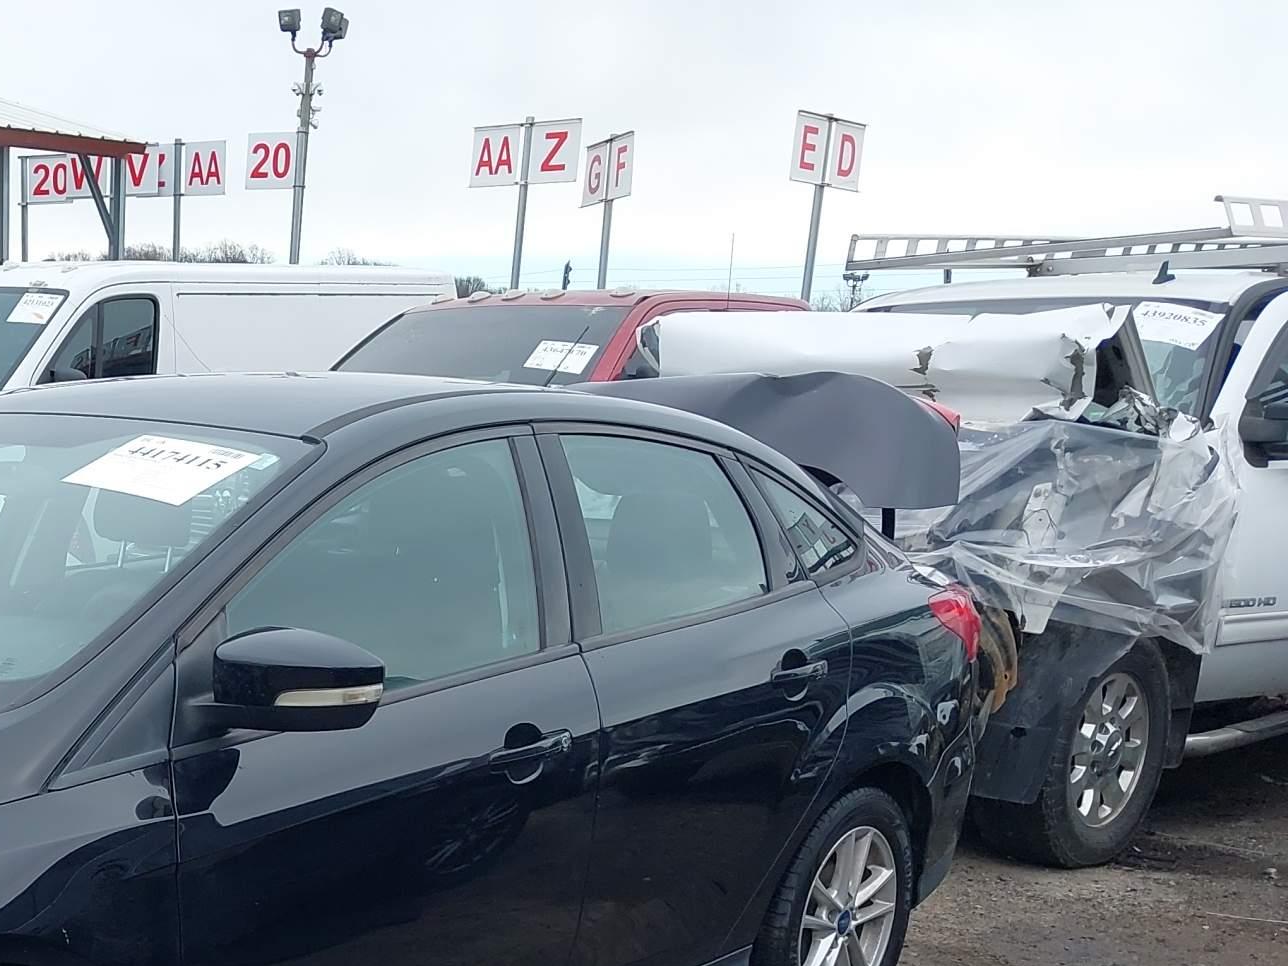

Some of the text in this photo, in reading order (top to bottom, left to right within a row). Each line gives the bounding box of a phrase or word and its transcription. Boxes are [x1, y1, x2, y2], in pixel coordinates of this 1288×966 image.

[188, 151, 222, 186] AA
[249, 142, 291, 179] 20
[475, 135, 513, 176] AA
[540, 131, 569, 172] Z
[614, 145, 628, 188] F
[799, 125, 819, 171] E
[837, 133, 857, 178] D
[32, 163, 67, 196] 20
[126, 153, 150, 187] V
[588, 154, 602, 195] G
[127, 446, 228, 470] 44174115
